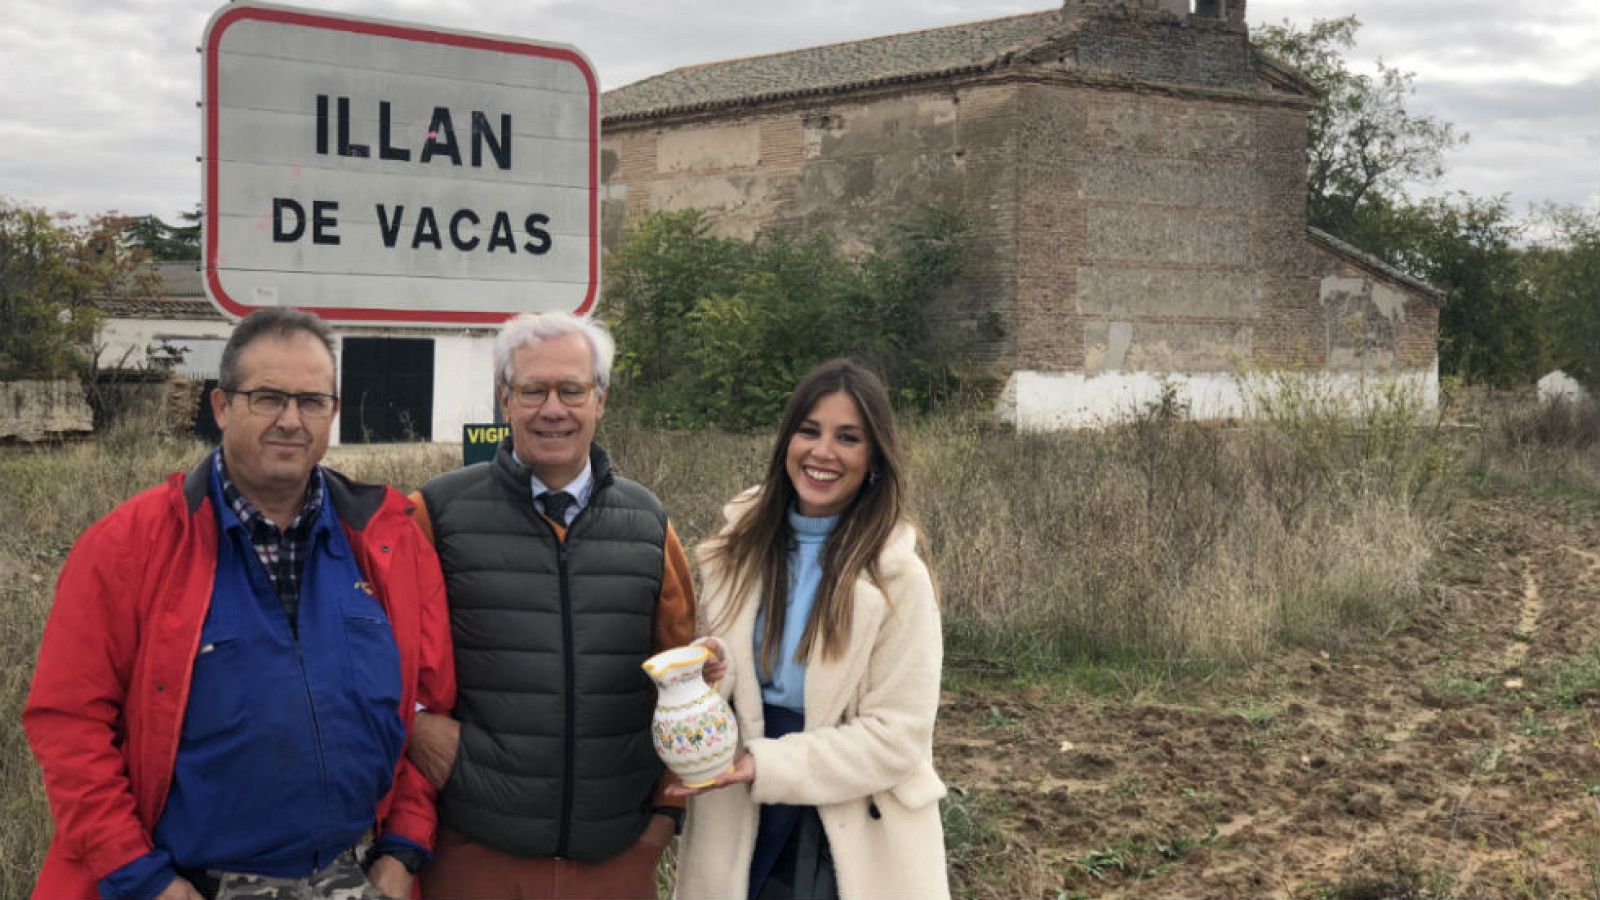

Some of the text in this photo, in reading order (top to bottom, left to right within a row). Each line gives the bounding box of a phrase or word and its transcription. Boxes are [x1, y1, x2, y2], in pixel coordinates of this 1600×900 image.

[316, 94, 512, 171] ILLAN
[272, 197, 552, 256] DE VACAS
